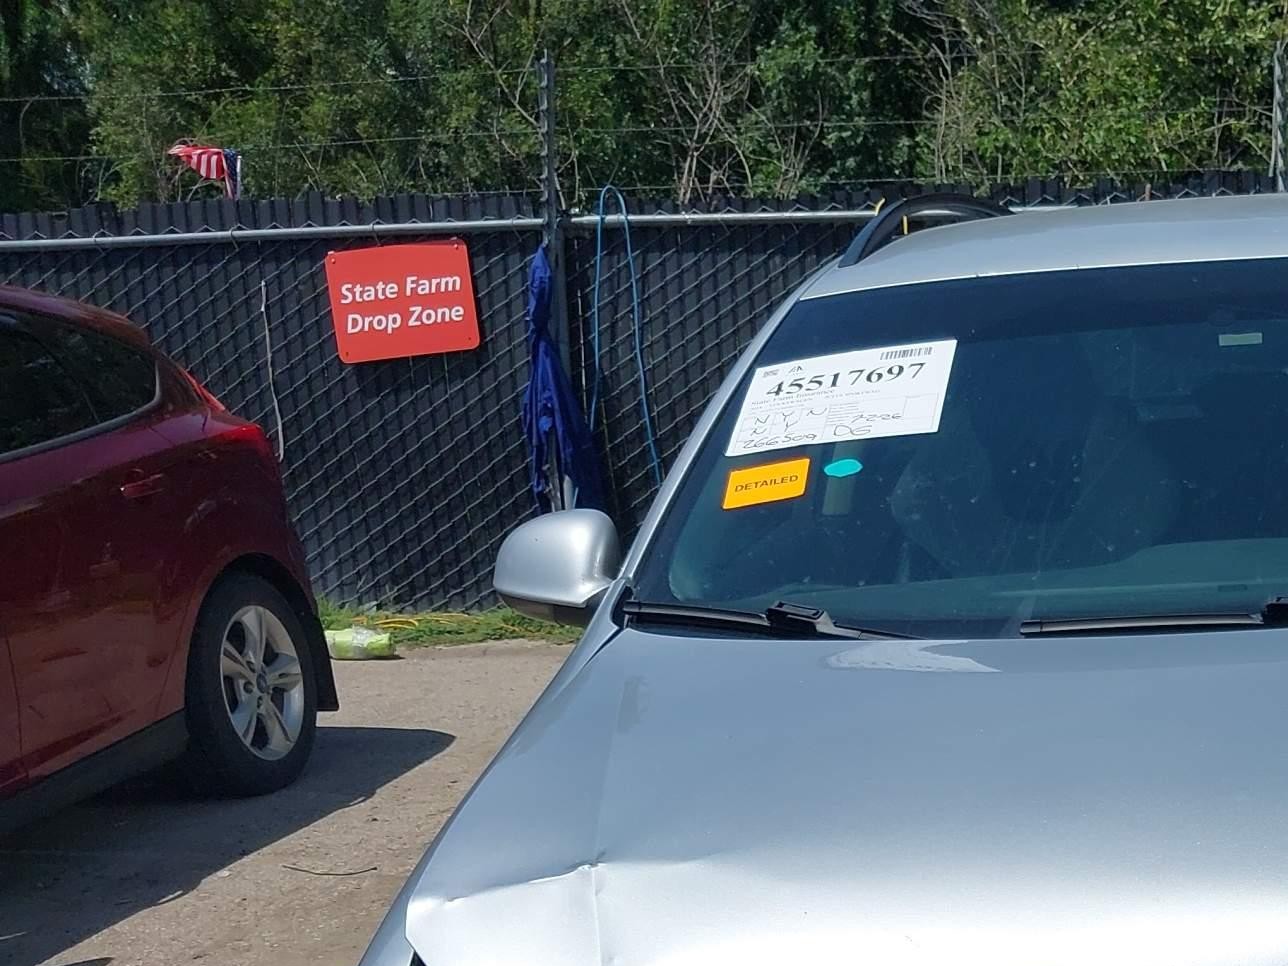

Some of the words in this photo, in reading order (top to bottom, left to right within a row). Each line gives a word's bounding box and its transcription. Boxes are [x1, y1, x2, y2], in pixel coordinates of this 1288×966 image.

[340, 280, 399, 304] State
[405, 275, 461, 297] Farm
[347, 312, 402, 334] Drop
[408, 305, 464, 327] Zone
[766, 362, 925, 397] 45517697
[734, 475, 799, 493] DETAILED
